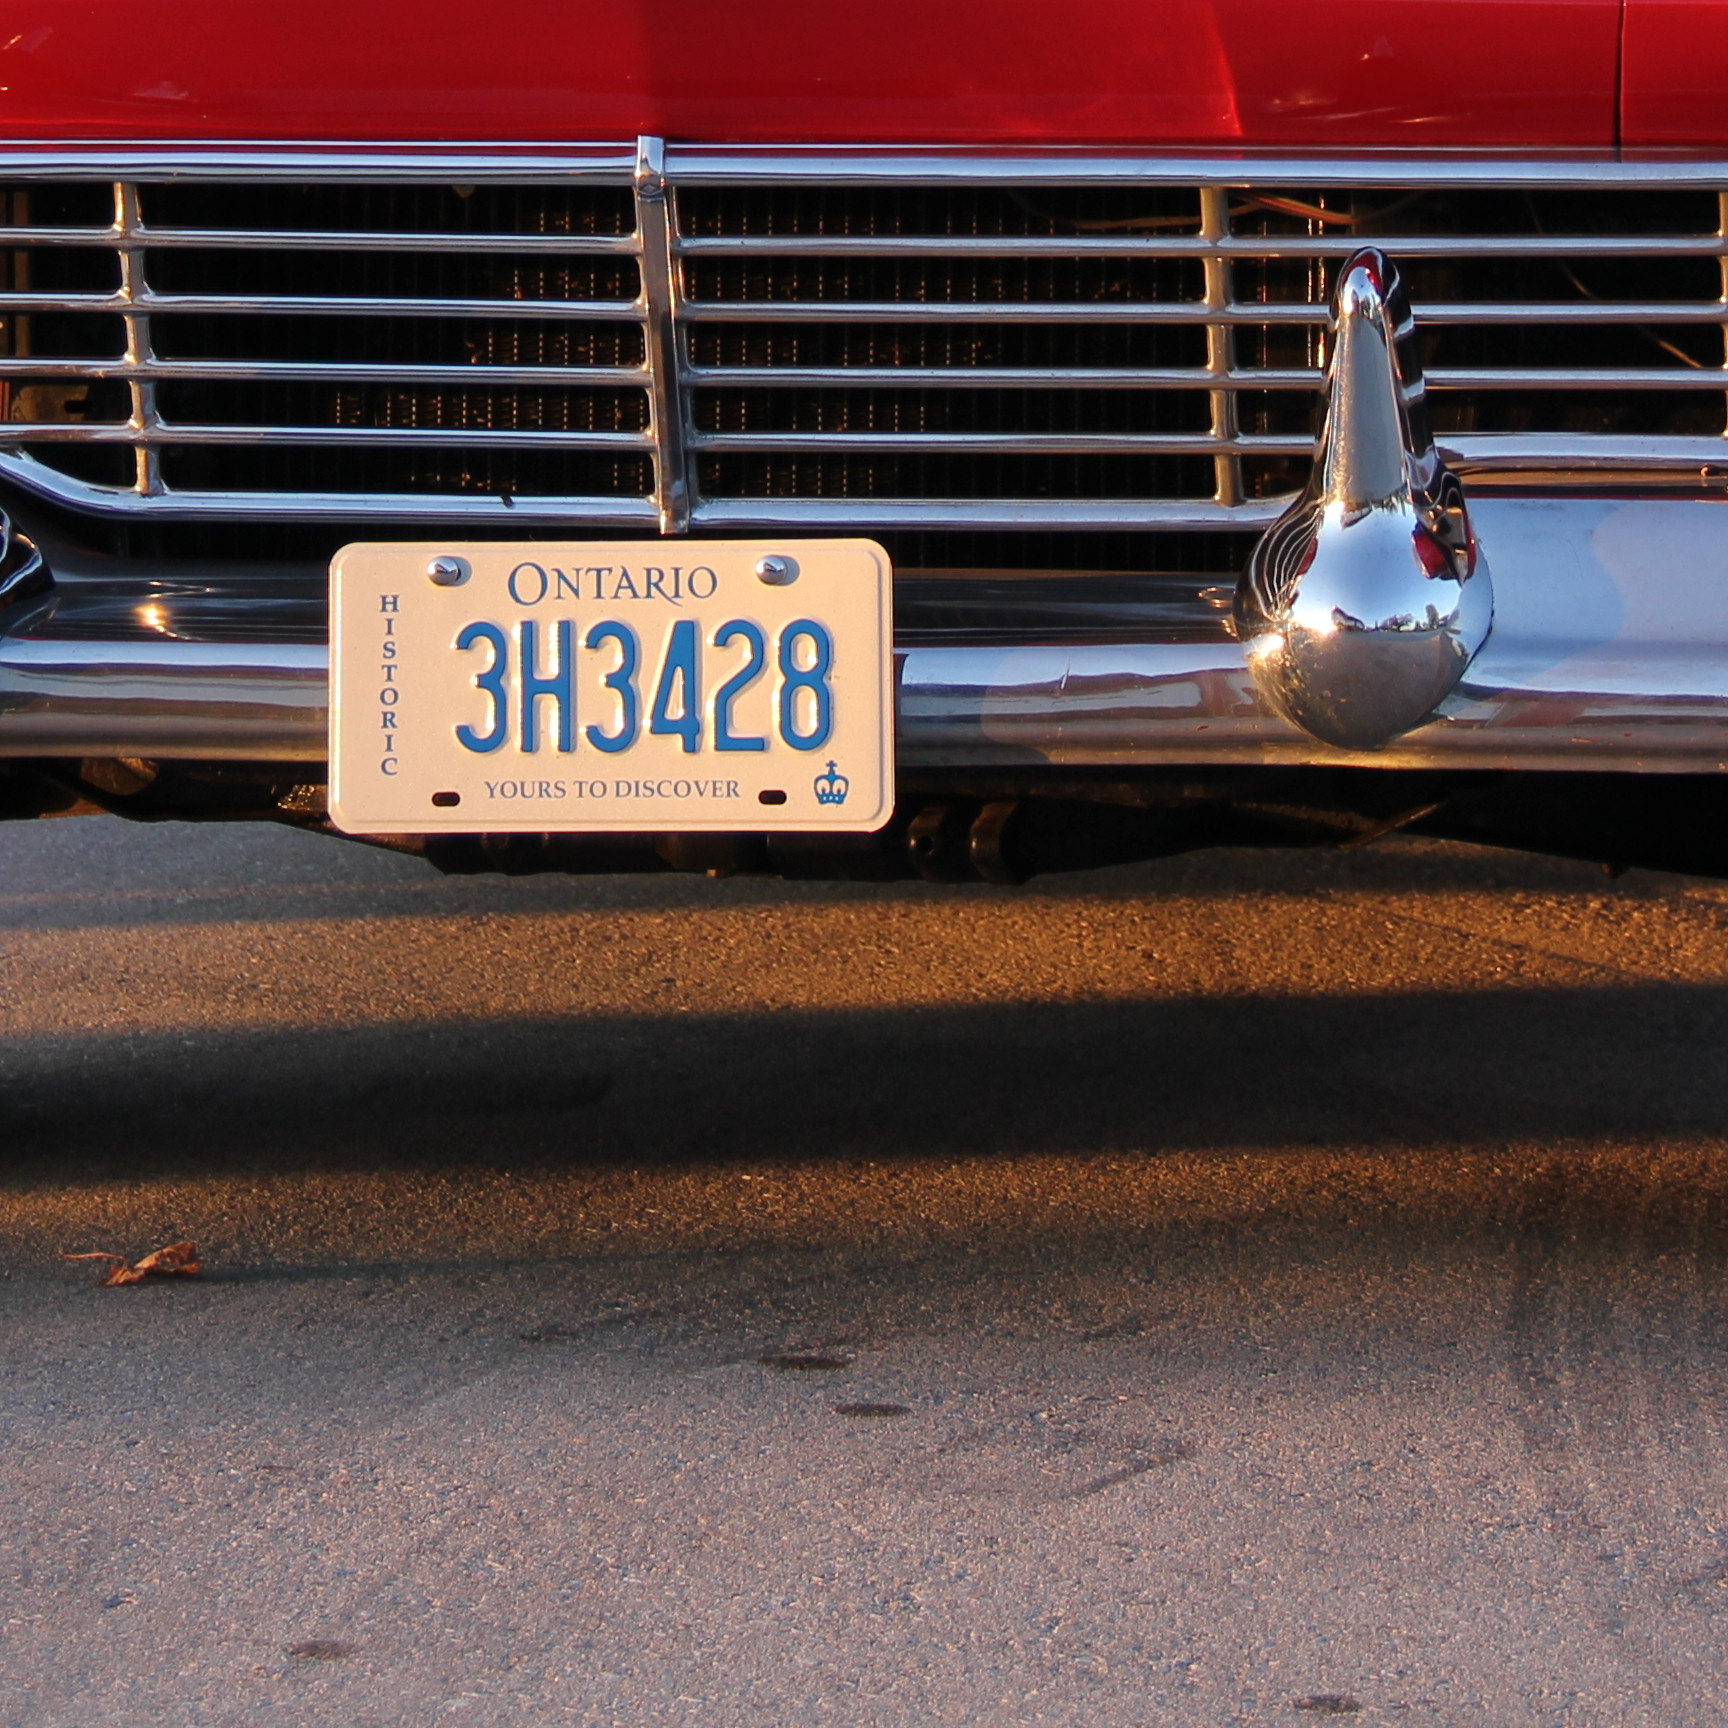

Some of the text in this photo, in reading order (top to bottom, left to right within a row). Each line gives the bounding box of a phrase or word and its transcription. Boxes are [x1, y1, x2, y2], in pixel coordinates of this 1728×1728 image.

[379, 594, 400, 777] HISTORIC
[455, 619, 833, 753] 3H3428
[484, 779, 741, 800] YOURS TO DISCOVER
